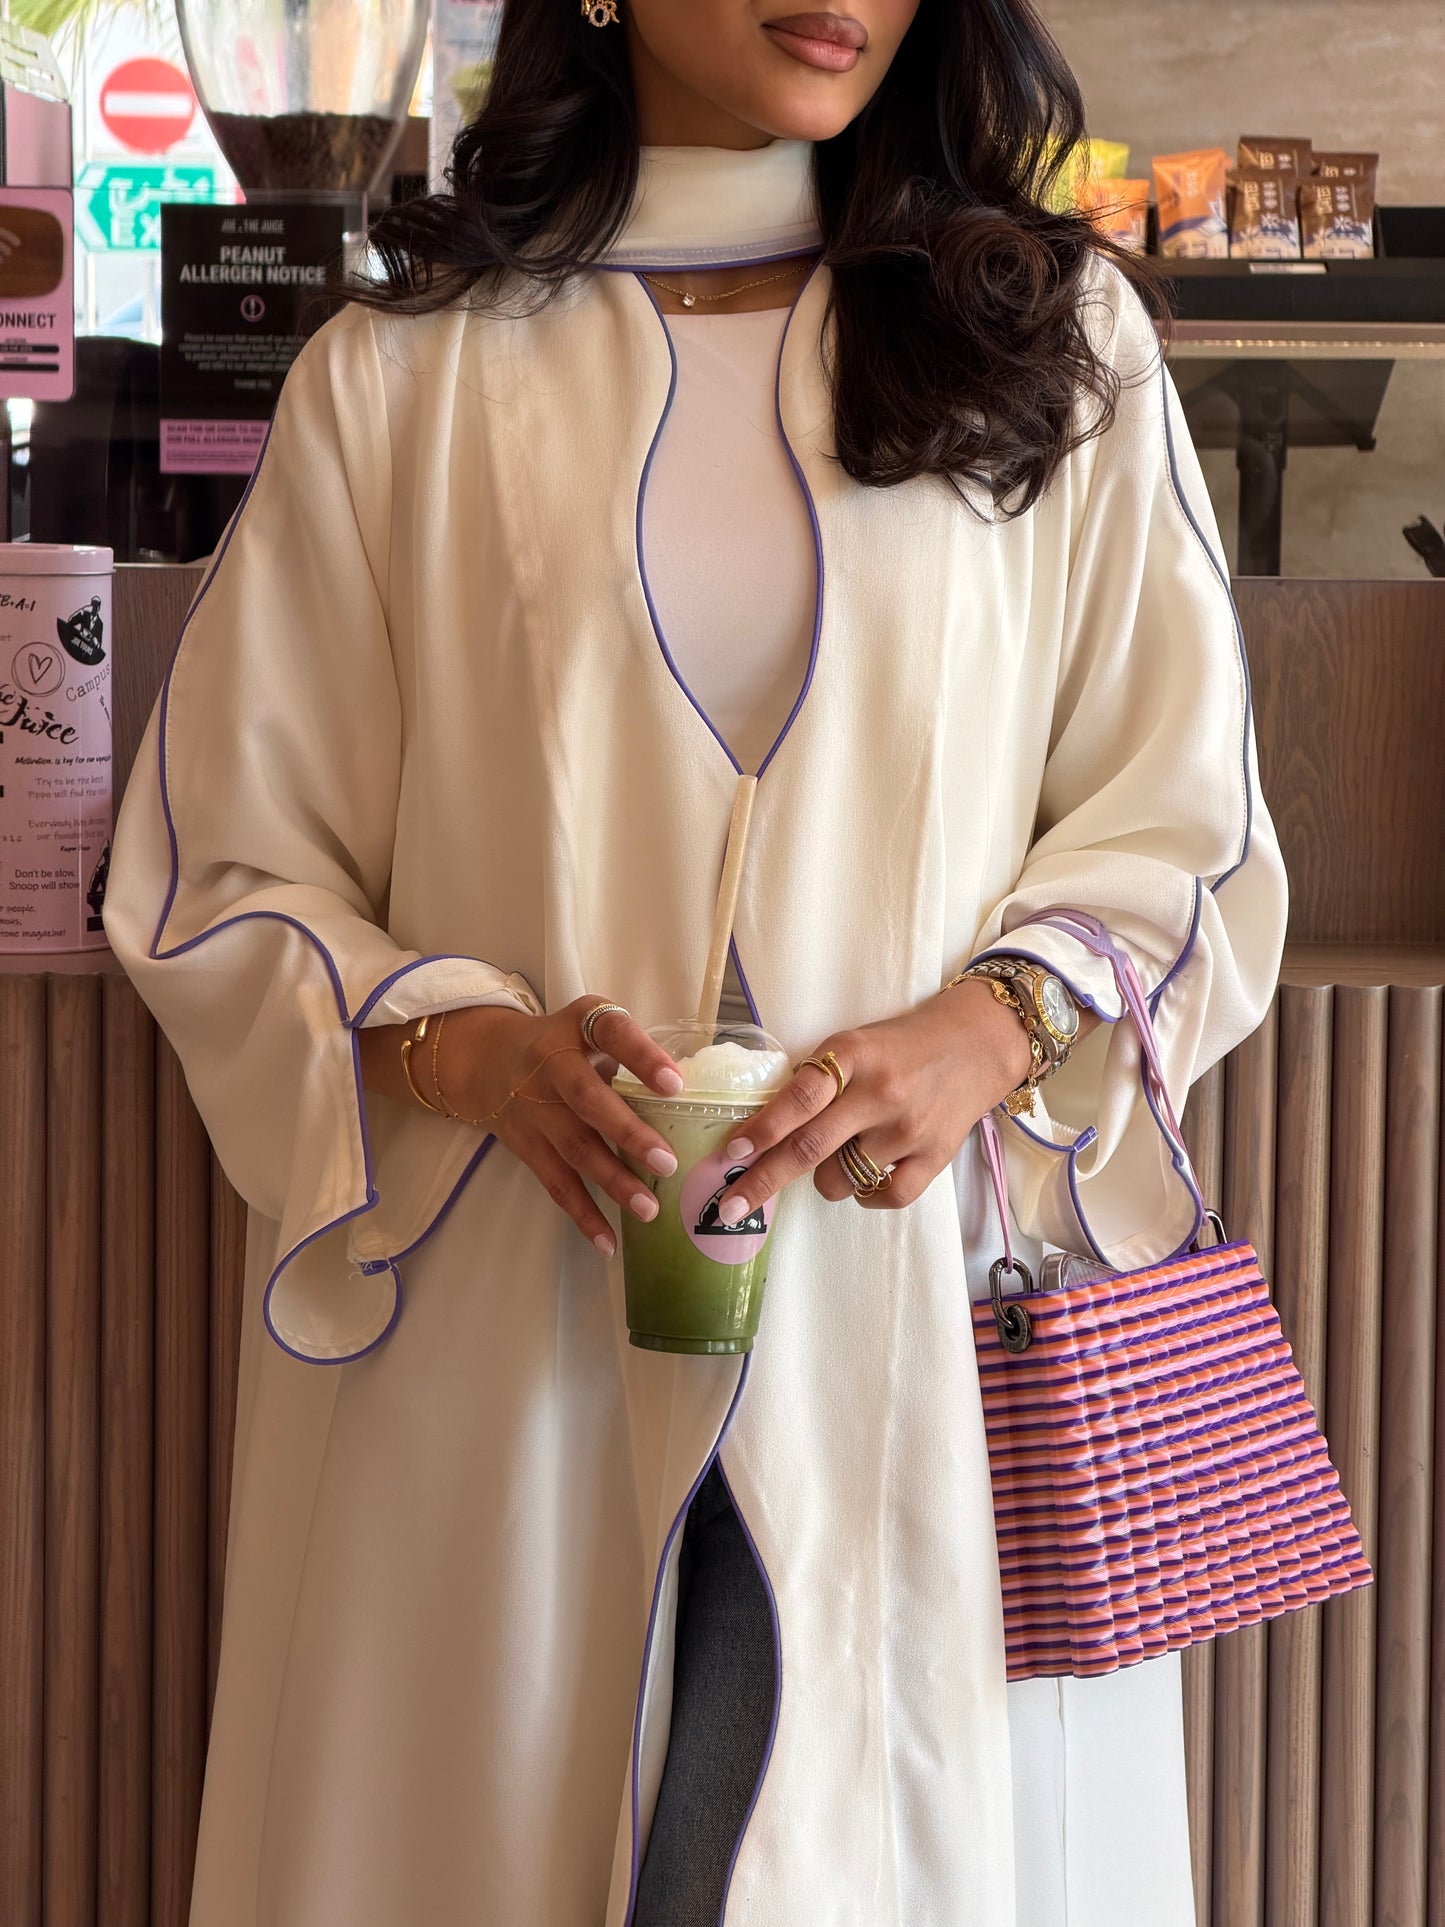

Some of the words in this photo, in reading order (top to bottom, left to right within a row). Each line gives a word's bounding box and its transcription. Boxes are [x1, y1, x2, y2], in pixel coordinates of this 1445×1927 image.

[220, 246, 286, 264] PEANUT
[179, 264, 262, 283] ALLERGEN
[266, 266, 326, 285] NOTICE
[66, 664, 110, 701] Campus
[0, 695, 79, 744] Juice
[15, 869, 39, 878] Don't
[41, 869, 53, 878] be
[9, 882, 39, 891] Snoop
[41, 881, 56, 889] will
